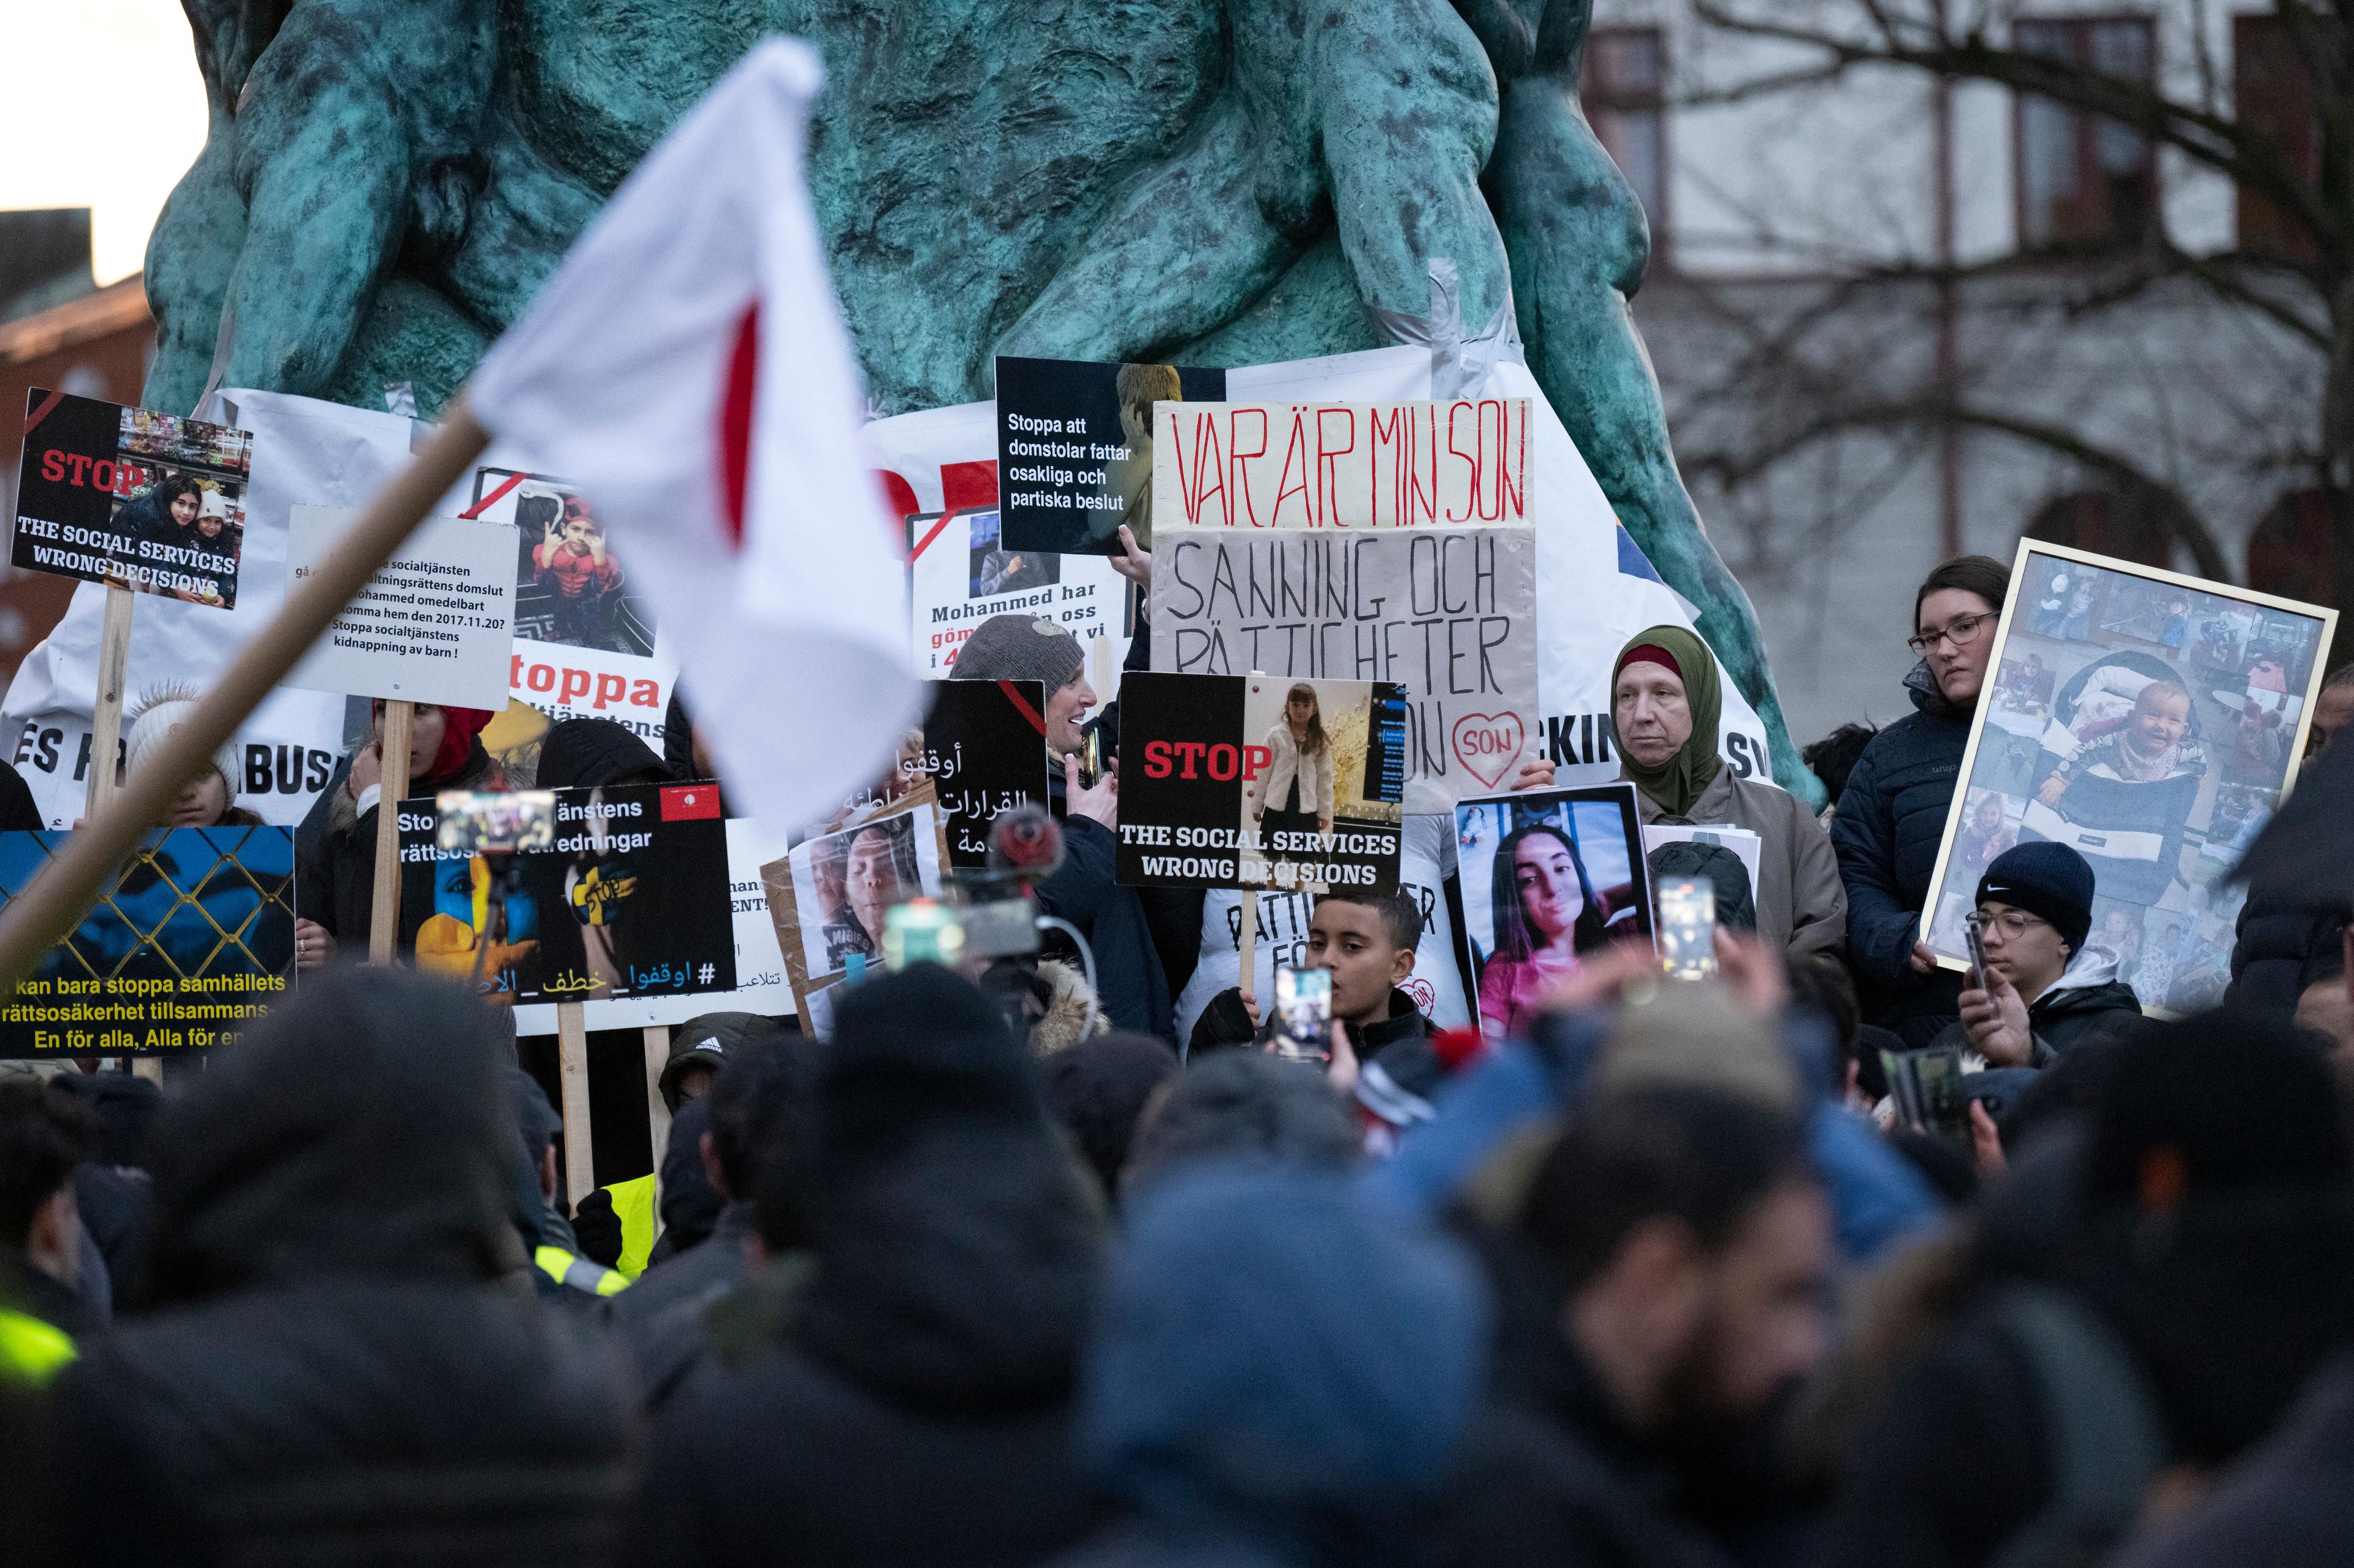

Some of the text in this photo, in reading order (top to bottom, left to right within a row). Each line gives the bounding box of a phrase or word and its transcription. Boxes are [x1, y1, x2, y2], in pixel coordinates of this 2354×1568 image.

[1008, 413, 1086, 436] Stoppa att
[1009, 440, 1131, 460] domstolar fattar
[1172, 400, 1525, 528] VAR ÄR MIN SON
[42, 449, 144, 496] STOP
[1010, 466, 1106, 487] osakliga och
[1010, 492, 1124, 511] partiska beslut
[18, 516, 235, 574] THE SOCIAL SERVICES
[34, 546, 219, 597] WRONG DECISIONS
[295, 566, 309, 578] gå
[456, 582, 503, 596] domslut
[391, 560, 471, 577] socialtjänsten
[1167, 535, 1496, 623] SANNING OCH
[355, 589, 484, 611] ohammed omedelbart
[932, 588, 1052, 622] Mohammed
[1062, 584, 1095, 600] har
[333, 620, 459, 642] Stoppa socialtjänstens
[384, 606, 408, 620] hem
[411, 611, 432, 623] den
[436, 614, 505, 630] 2017.11.20?
[932, 625, 980, 649] göm
[1062, 606, 1096, 622] oss
[334, 636, 406, 655] kidnappning
[409, 645, 422, 655] av
[425, 644, 451, 658] barn
[931, 653, 936, 668] i
[1086, 623, 1104, 639] vi
[509, 653, 659, 710] toppa
[1463, 728, 1512, 756] SON
[238, 744, 345, 794] BUS
[896, 742, 962, 780] أوقفوا
[1144, 740, 1273, 782] STOP
[398, 801, 642, 832] Sto änstens
[400, 843, 481, 862] rättsos
[1120, 824, 1396, 855] THE SOCIAL SERVICES
[1141, 856, 1376, 885] WRONG DECISIONS
[16, 974, 285, 997] kan bara stoppa samhällets
[1409, 986, 1433, 1008] ON
[2, 1003, 145, 1022] rättsosäkerhet
[35, 1030, 60, 1048] En
[66, 1030, 94, 1048] för
[99, 1029, 139, 1050] alla,
[145, 1029, 183, 1047] Alla
[188, 1027, 216, 1046] för
